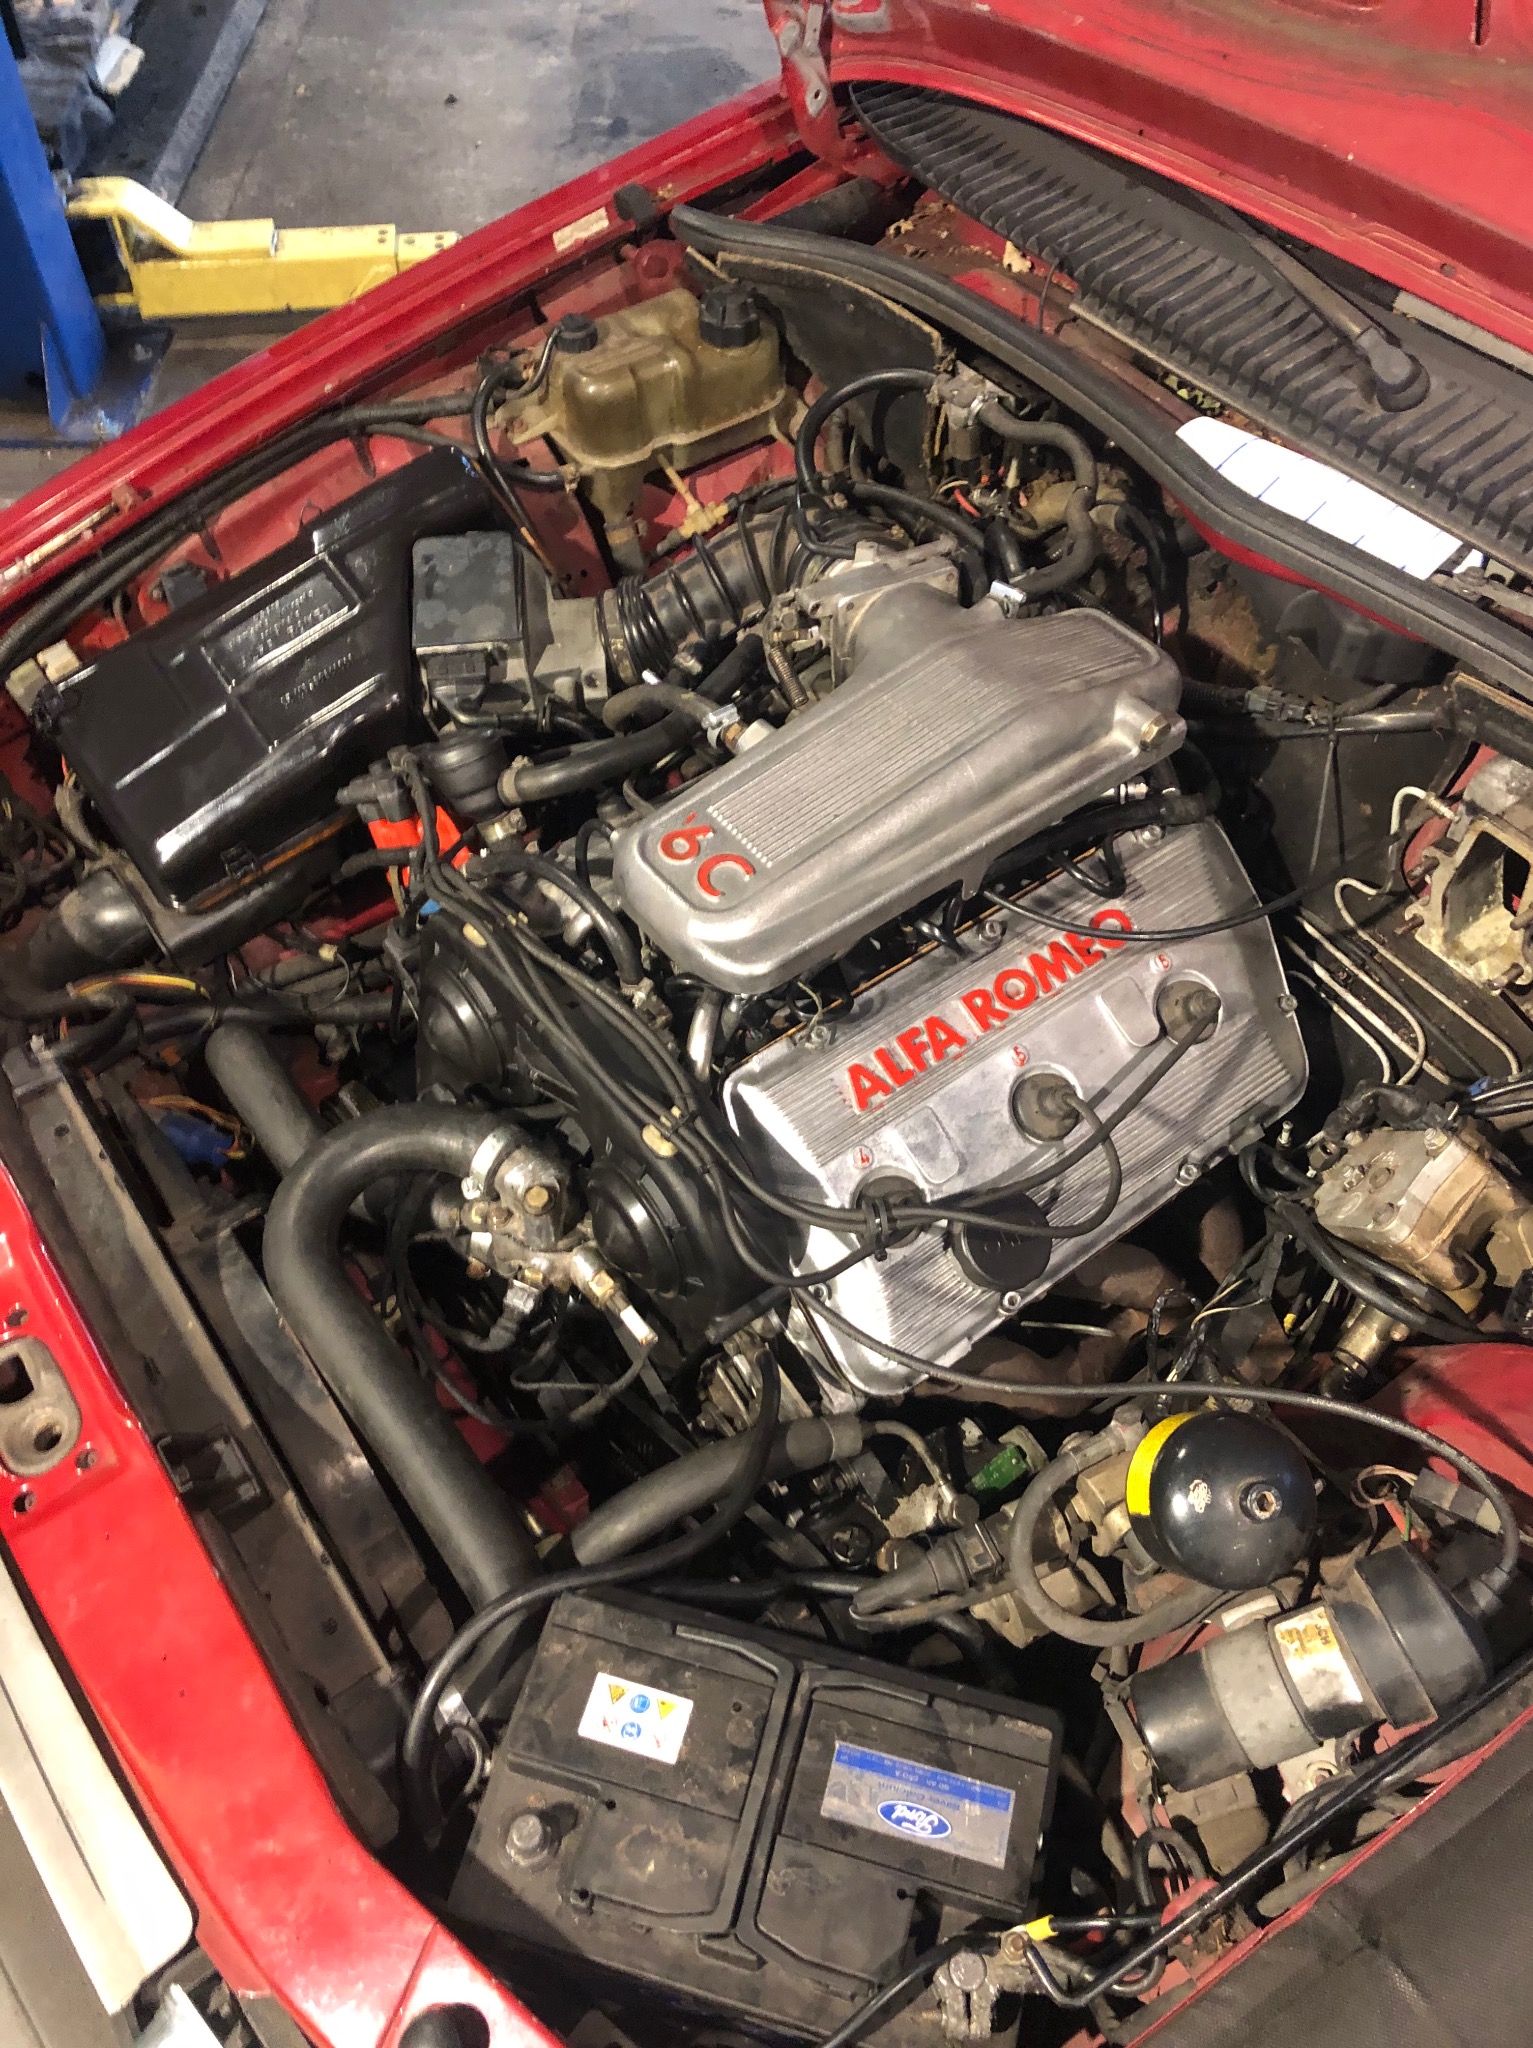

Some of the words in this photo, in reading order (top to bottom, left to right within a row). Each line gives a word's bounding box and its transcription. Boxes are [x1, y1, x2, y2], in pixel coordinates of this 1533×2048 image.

[847, 1015, 968, 1112] ALFA
[961, 908, 1134, 1032] ROMEO
[1012, 1045, 1027, 1067] 5
[890, 1803, 940, 1835] Ford
